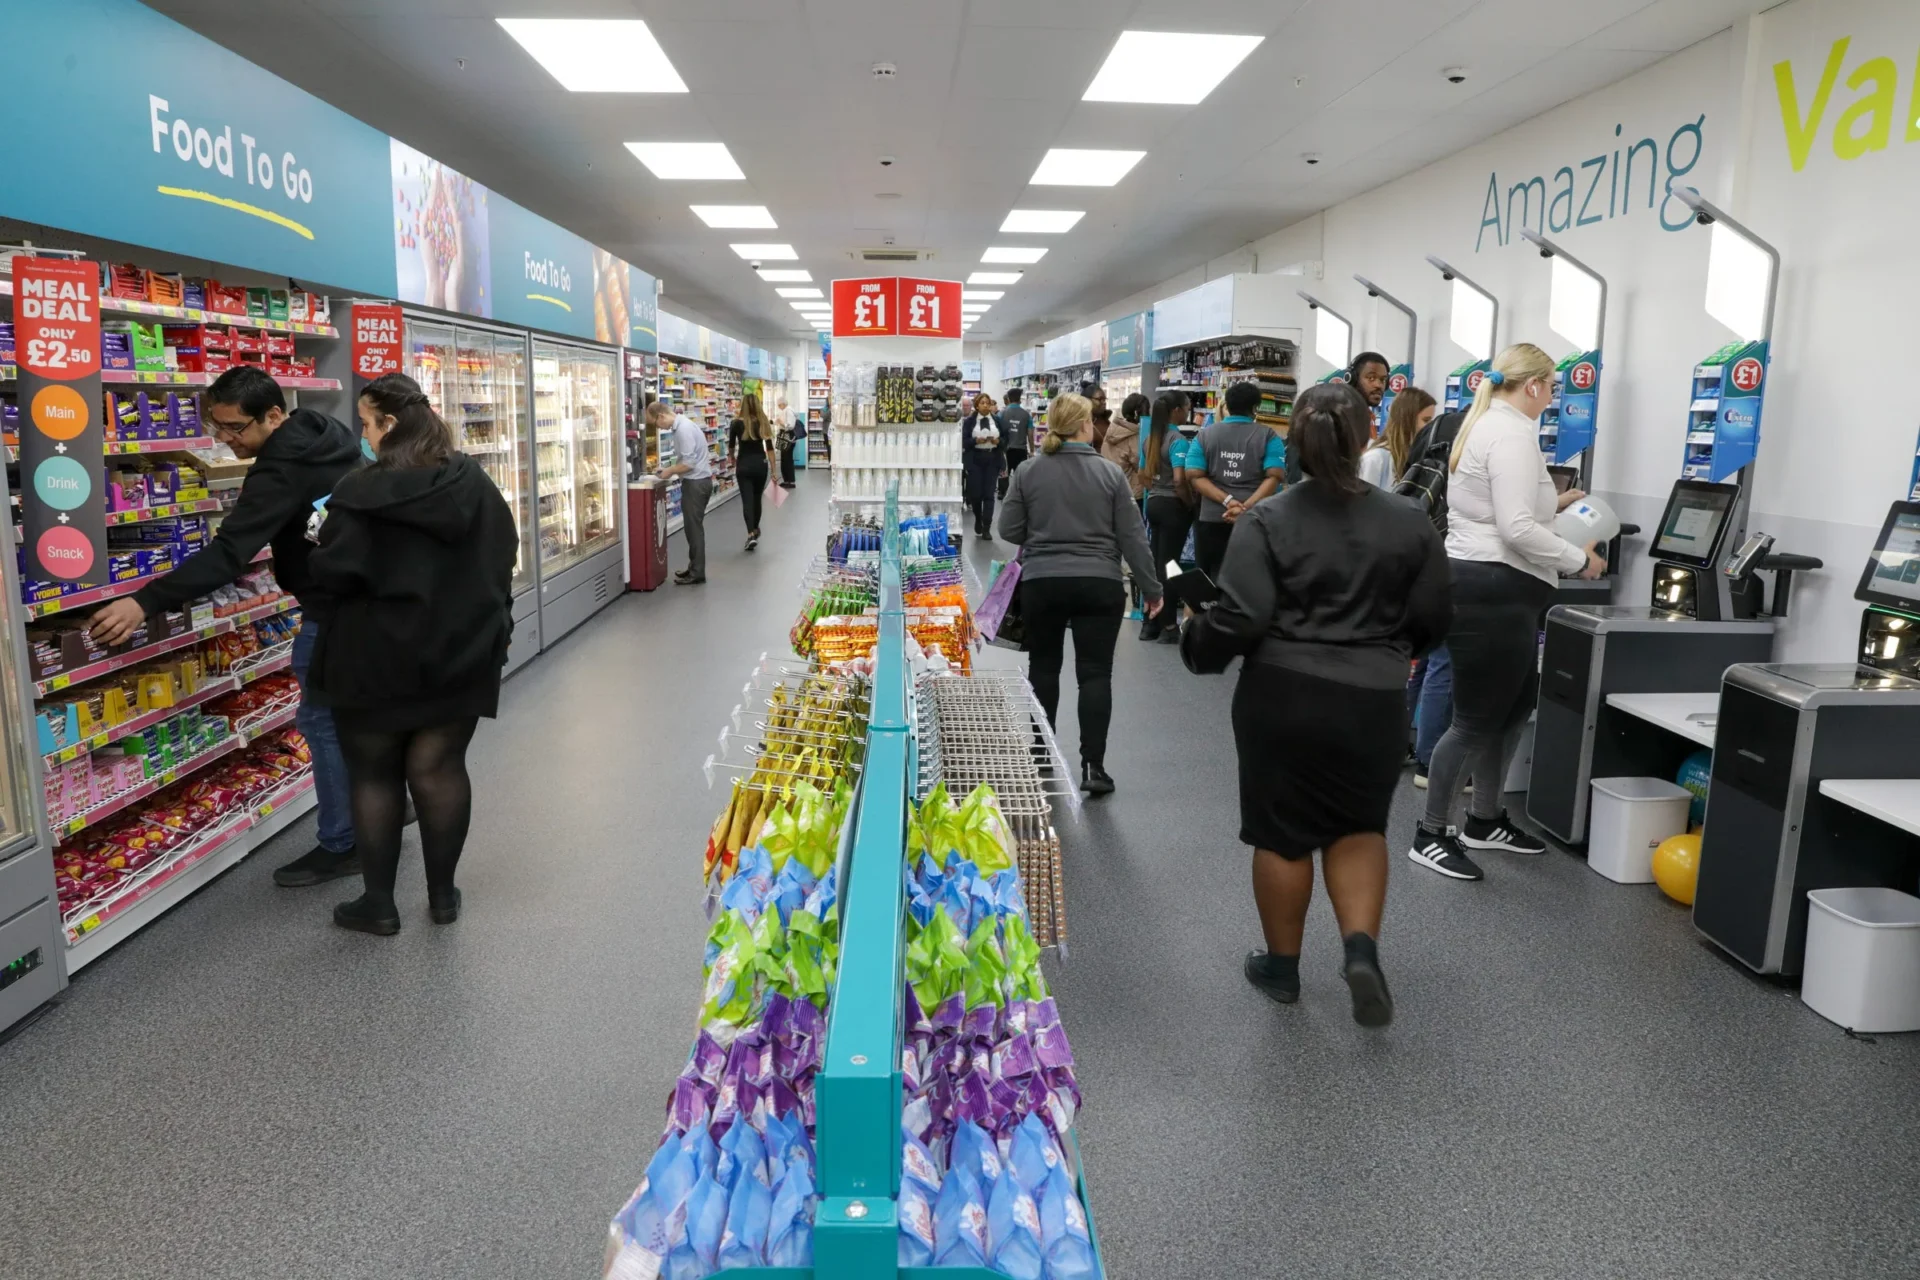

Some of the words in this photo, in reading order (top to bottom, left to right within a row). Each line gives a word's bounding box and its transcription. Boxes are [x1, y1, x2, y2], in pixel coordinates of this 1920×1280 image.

[149, 94, 234, 178] Food
[241, 133, 274, 190] To
[282, 152, 313, 204] Go
[1474, 113, 1706, 254] Amazing
[524, 251, 548, 285] Food
[549, 260, 559, 288] To
[561, 266, 571, 292] Go
[22, 278, 91, 301] MEAL
[861, 284, 880, 293] FROM
[916, 284, 936, 294] FROM
[22, 298, 92, 322] DEAL
[854, 294, 886, 327] £1
[909, 295, 940, 328] £1
[357, 318, 398, 331] MEAL
[39, 327, 76, 339] ONLY
[357, 331, 398, 344] DEAL
[27, 339, 91, 368] £2.50
[359, 355, 397, 372] £2.50
[1574, 368, 1593, 384] £1
[1737, 366, 1759, 385] £1
[45, 405, 75, 419] Main
[1220, 451, 1246, 461] Happy
[1223, 470, 1242, 478] Help
[47, 476, 79, 490] Drink
[47, 545, 85, 560] Snack
[155, 561, 173, 572] YORKIE
[118, 568, 139, 580] YORKIE
[37, 586, 62, 599] YORKIE
[100, 588, 115, 598] Snack
